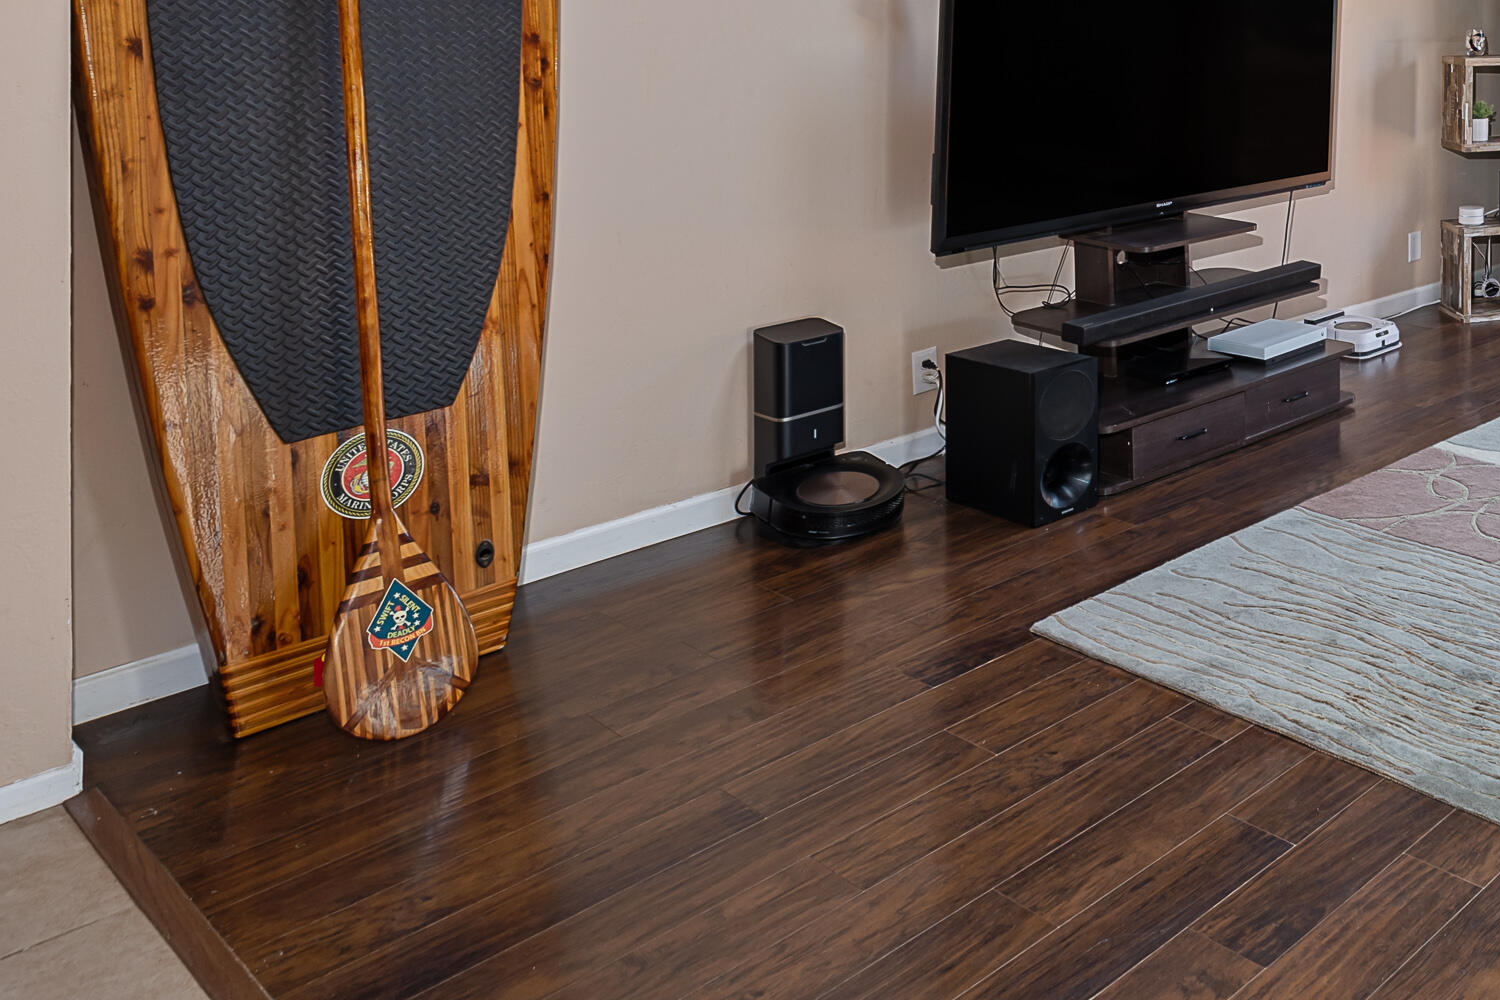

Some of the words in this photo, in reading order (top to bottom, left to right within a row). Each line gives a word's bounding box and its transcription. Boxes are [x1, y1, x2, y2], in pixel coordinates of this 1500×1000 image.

[335, 442, 367, 472] UNITE
[387, 439, 413, 462] TATES
[336, 493, 371, 509] MARIN
[391, 473, 414, 499] ORPS
[376, 601, 395, 626] SWIFT
[399, 594, 421, 613] SILENT
[387, 625, 416, 639] DEADLY
[391, 633, 416, 646] RECON
